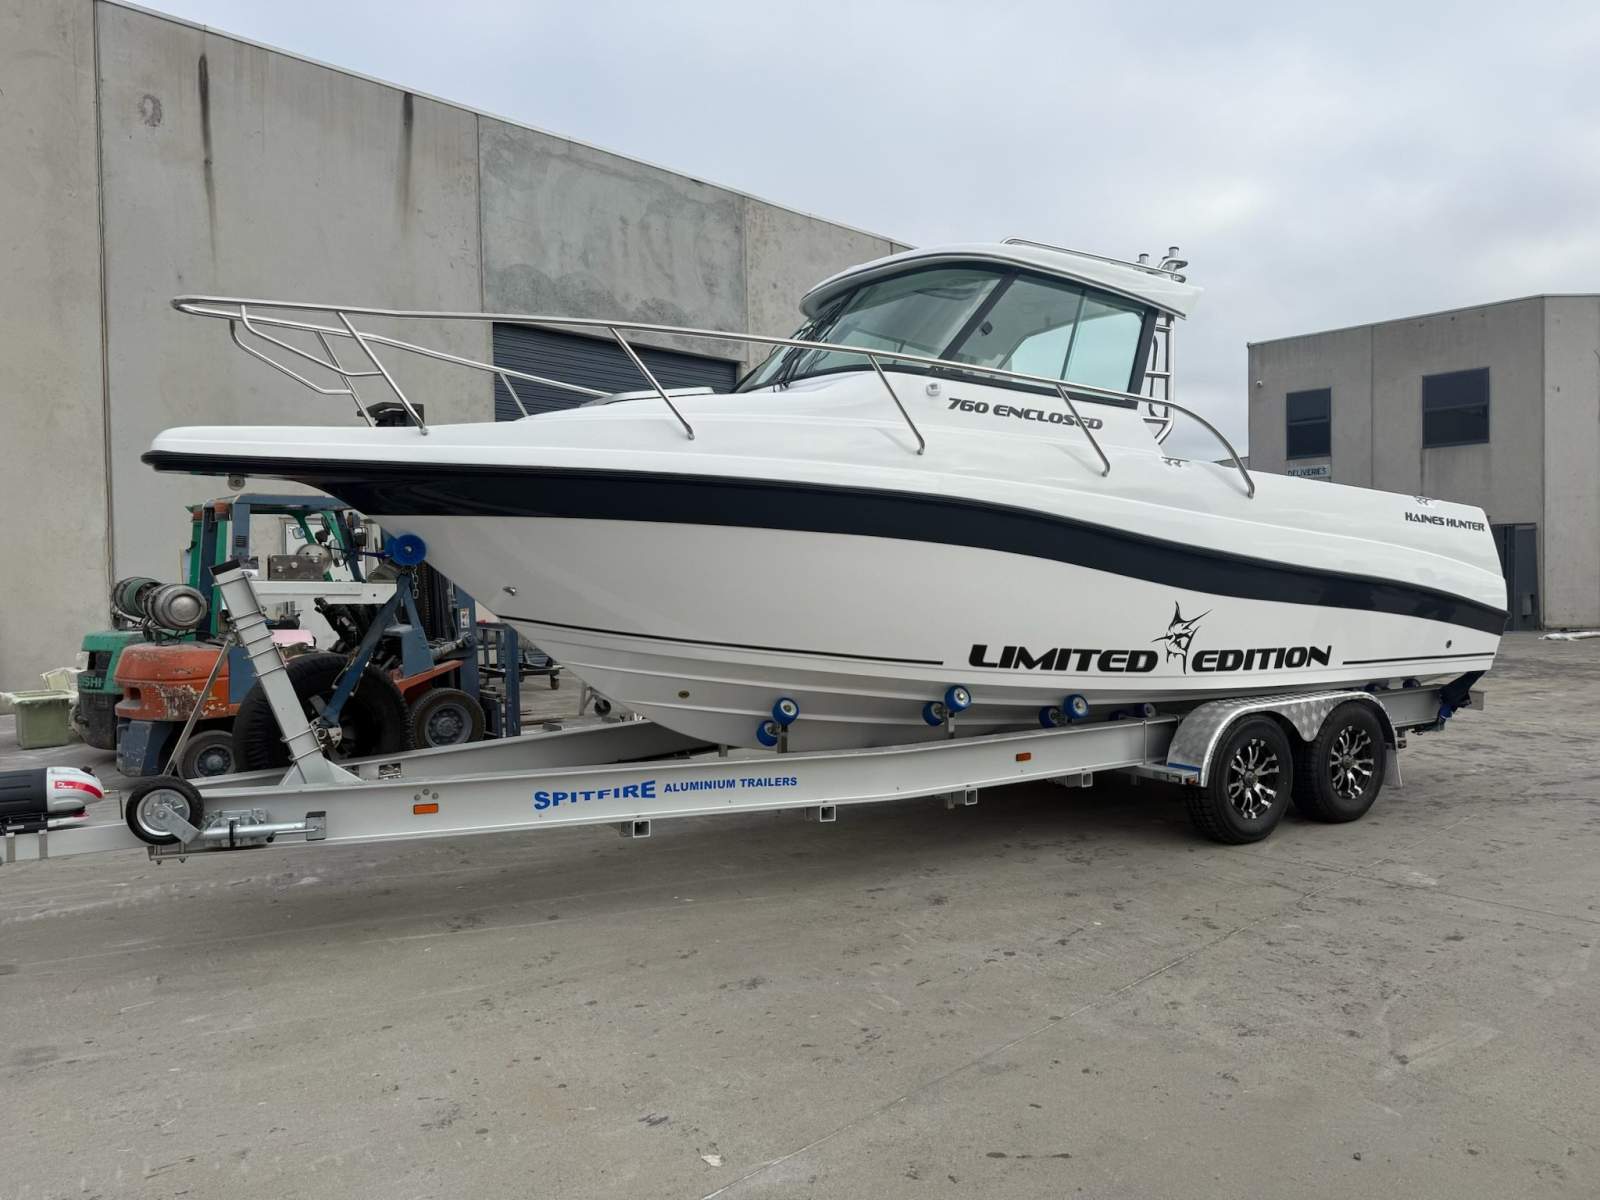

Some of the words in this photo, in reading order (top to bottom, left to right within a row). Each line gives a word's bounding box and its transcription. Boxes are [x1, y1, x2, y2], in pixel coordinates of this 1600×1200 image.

[948, 397, 989, 413] 760
[1405, 512, 1445, 526] HAINES
[1446, 518, 1485, 531] HUNTER
[968, 644, 1159, 673] LIMITED
[1191, 644, 1332, 672] EDITION
[534, 780, 656, 810] SPITFIRE
[664, 779, 736, 793] ALUMINIUM
[740, 776, 797, 788] TRAILERS
